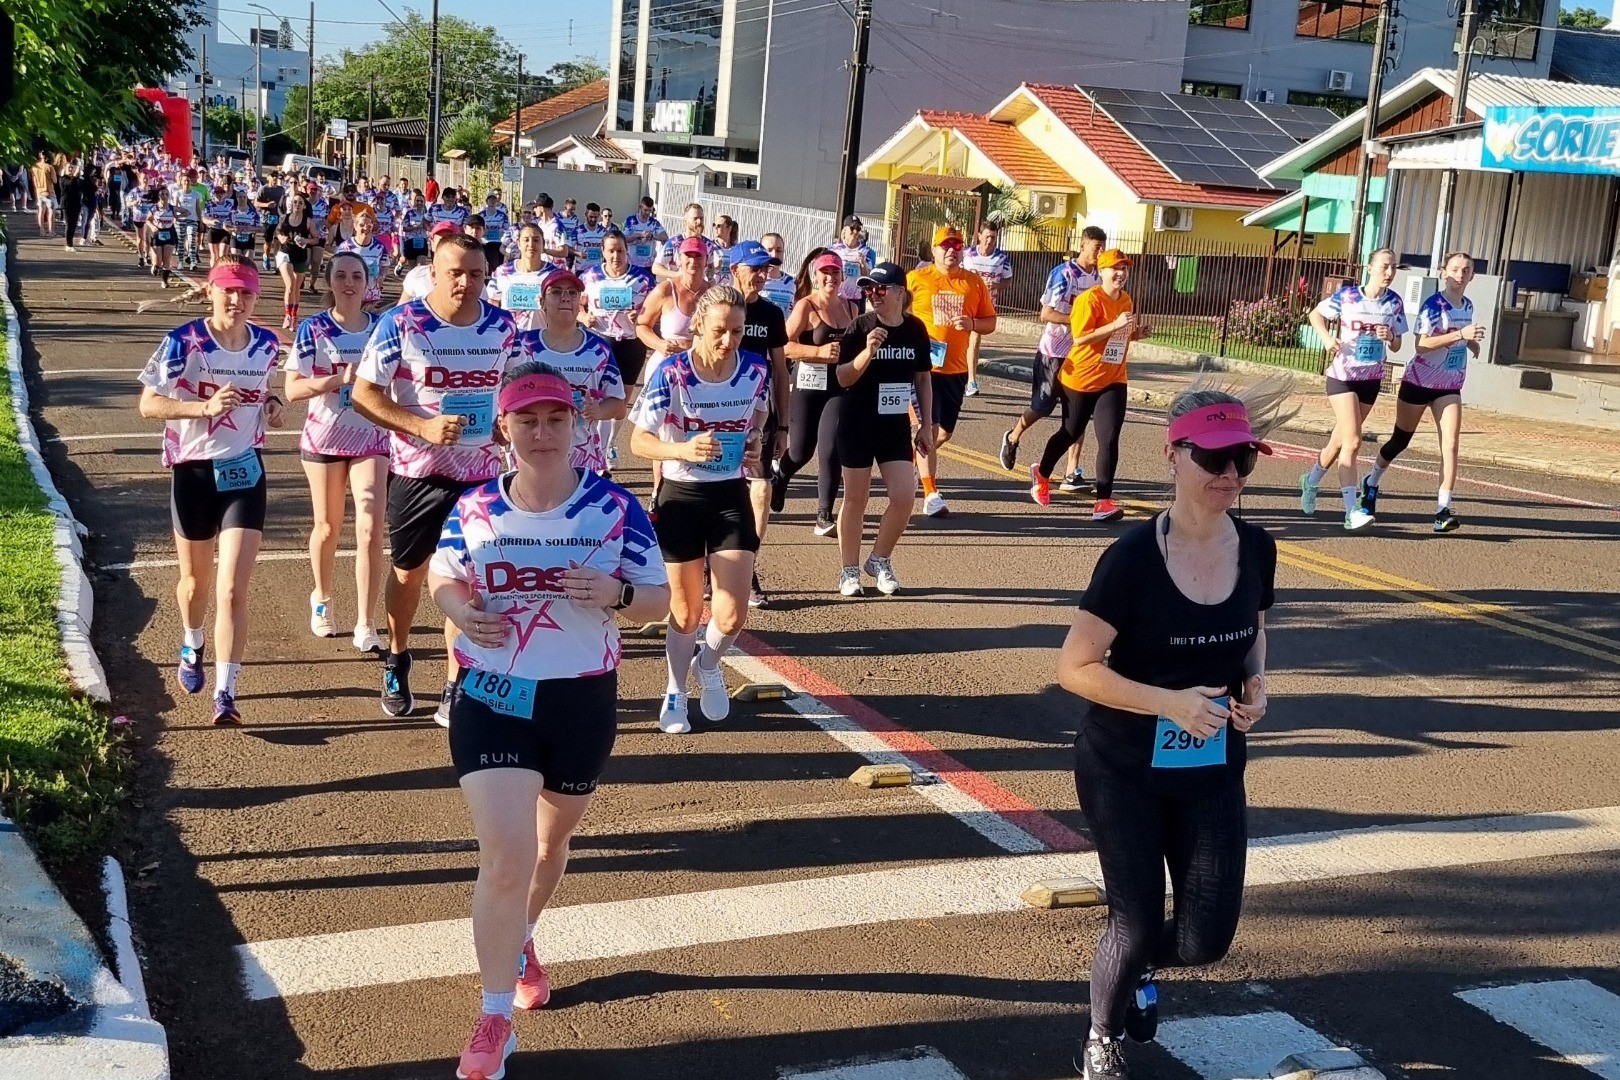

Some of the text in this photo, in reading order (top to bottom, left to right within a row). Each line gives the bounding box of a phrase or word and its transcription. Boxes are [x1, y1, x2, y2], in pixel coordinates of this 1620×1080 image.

[512, 294, 528, 302] 044
[432, 348, 465, 356] CORRIDA
[871, 344, 916, 360] mirates
[1104, 348, 1118, 357] 938
[1358, 346, 1374, 354] 120
[208, 368, 236, 376] CORRIDA
[424, 366, 500, 388] Dass
[800, 373, 817, 382] 927
[197, 381, 261, 403] Dss
[881, 395, 901, 406] 956
[683, 416, 748, 434] Dass
[220, 467, 248, 481] 153
[229, 480, 252, 488] DIONE
[493, 537, 542, 547] CORRIDA
[545, 535, 603, 548] SOLIDÁRIA
[485, 561, 571, 594] Das
[1188, 626, 1254, 645] TRAINING
[473, 670, 512, 699] 180
[480, 752, 519, 765] RUN
